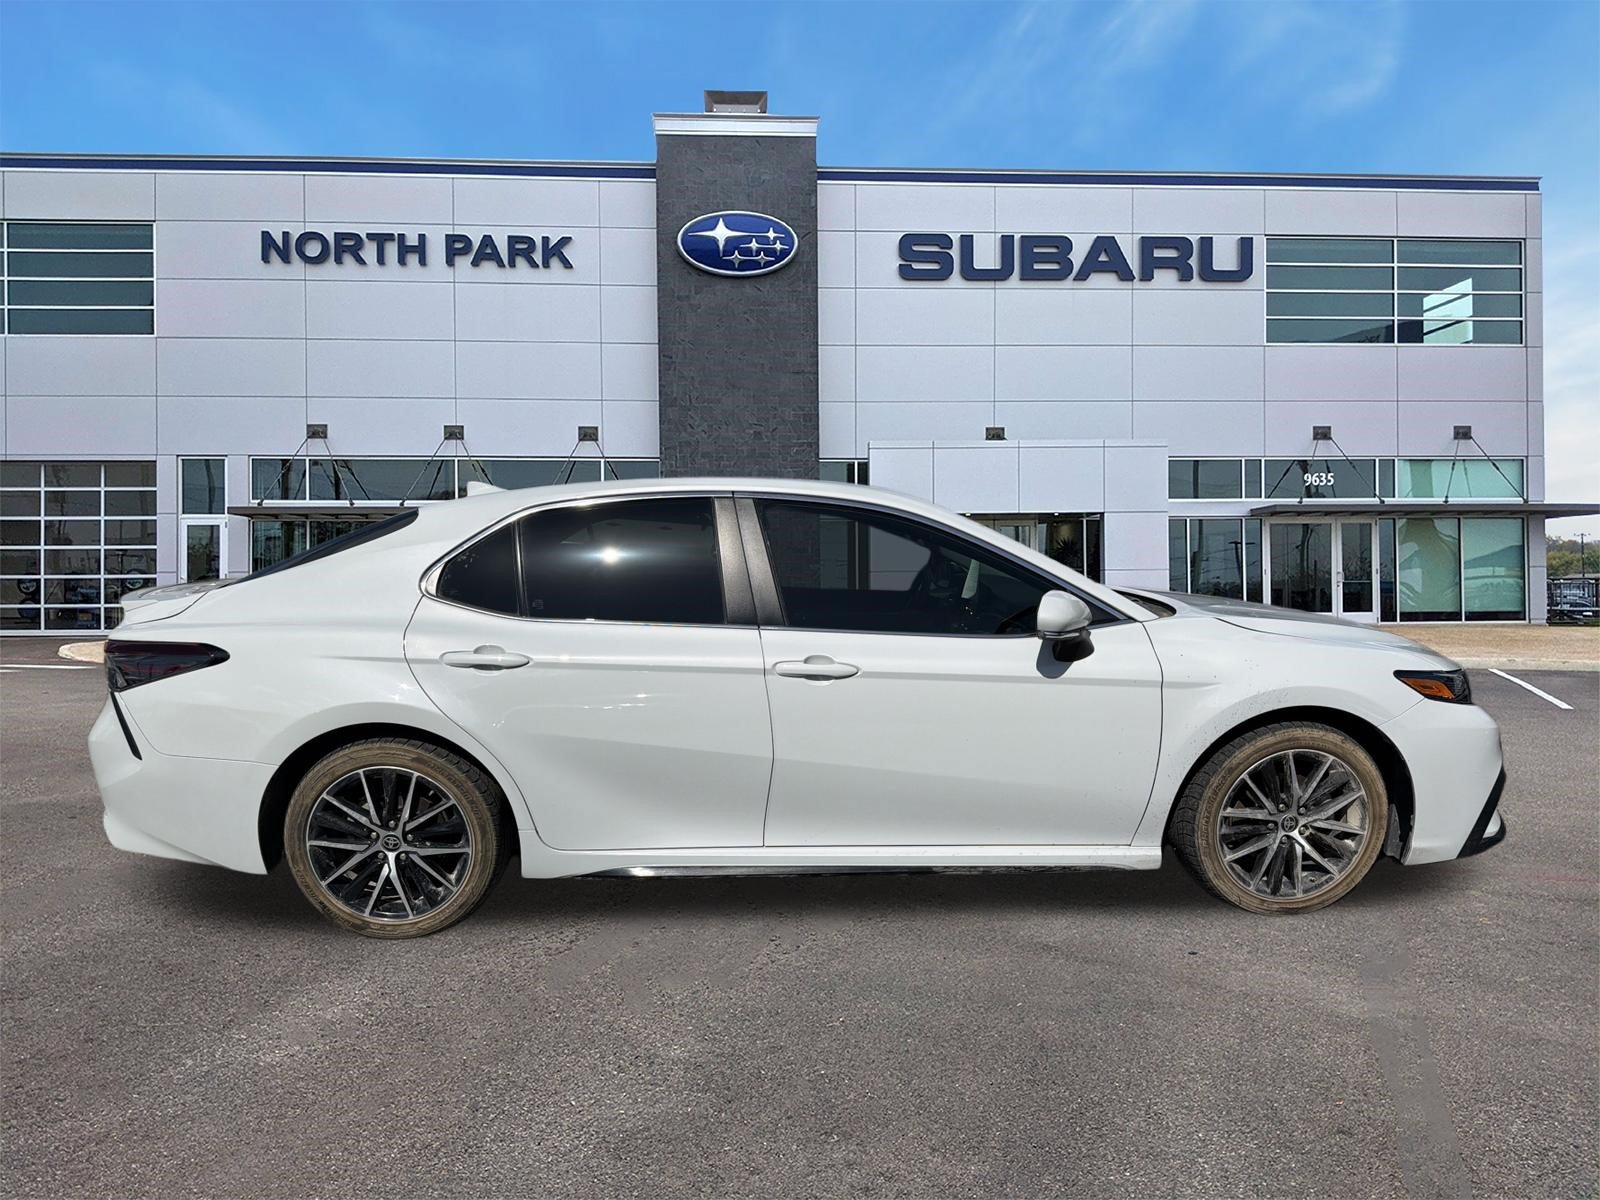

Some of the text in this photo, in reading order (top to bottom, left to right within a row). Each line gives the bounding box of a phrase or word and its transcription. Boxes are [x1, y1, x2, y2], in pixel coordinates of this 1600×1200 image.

[261, 230, 574, 269] NORTH PARK
[898, 233, 1254, 282] SUBARU
[1303, 472, 1335, 486] 9635
